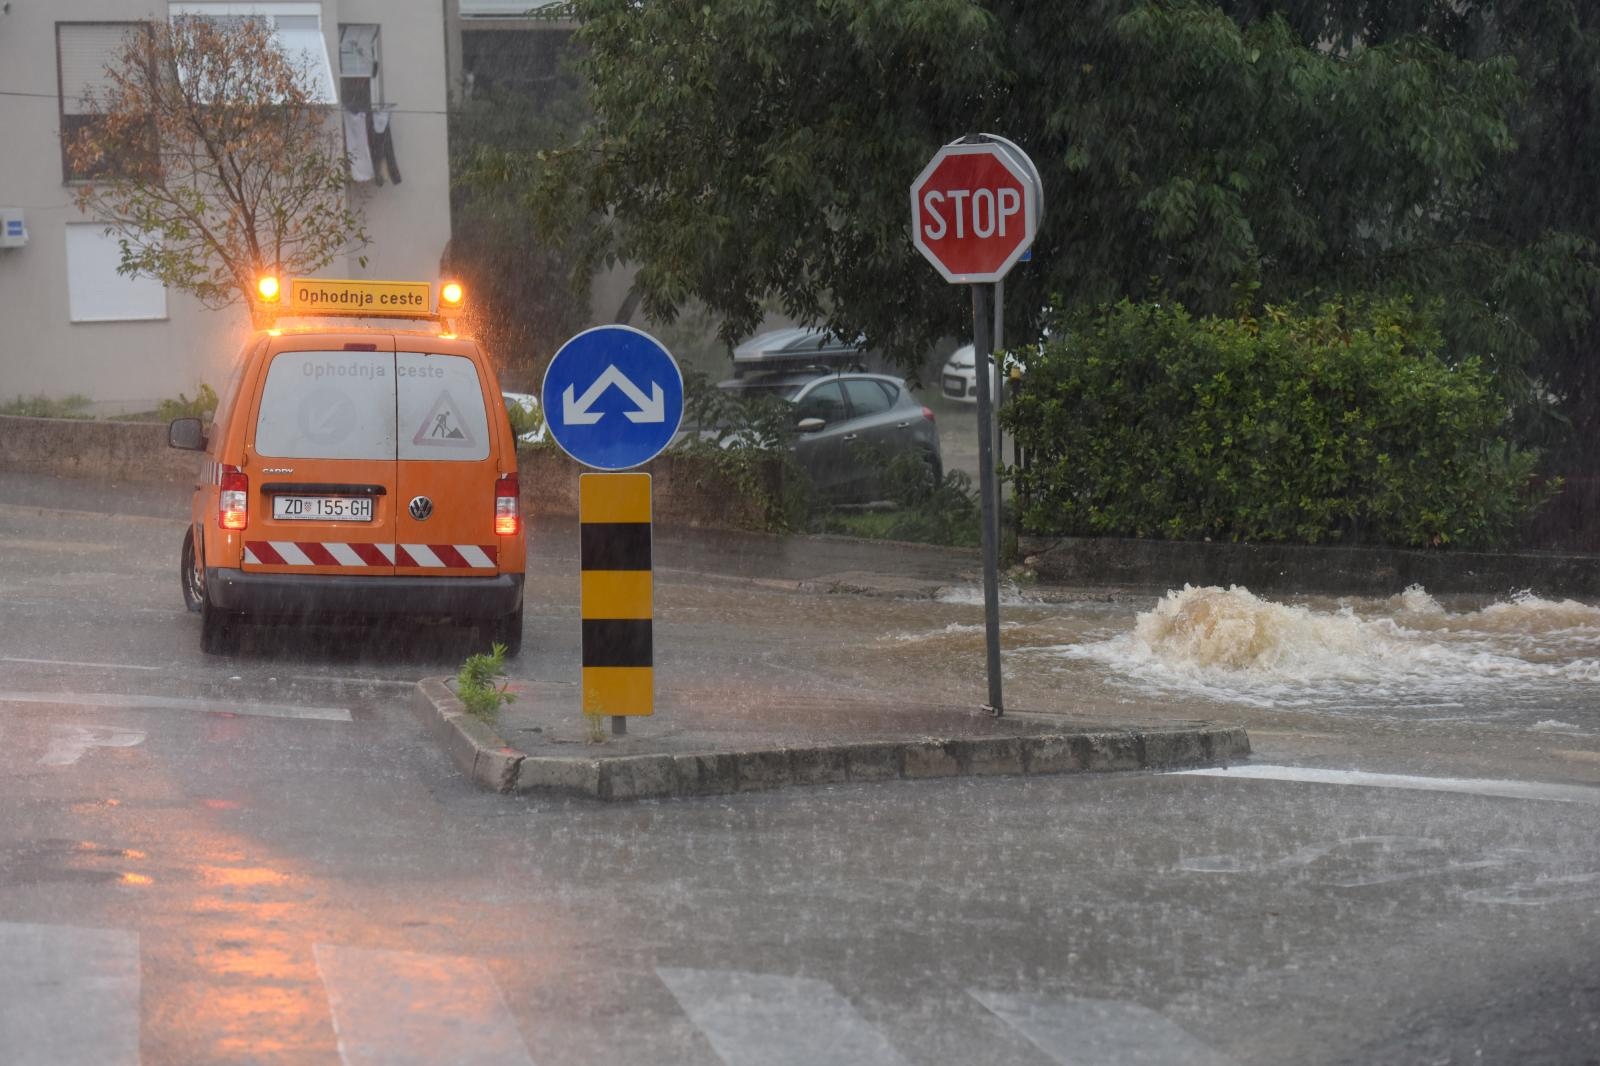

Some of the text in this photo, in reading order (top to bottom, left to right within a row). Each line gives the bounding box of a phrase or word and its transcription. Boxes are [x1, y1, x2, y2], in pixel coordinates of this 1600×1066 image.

[924, 188, 1020, 240] STOP
[299, 288, 423, 306] Ophodnja ceste
[303, 362, 444, 380] Ophodnja ceste
[285, 499, 370, 516] ZD 155-GH
[409, 496, 433, 520] VW
